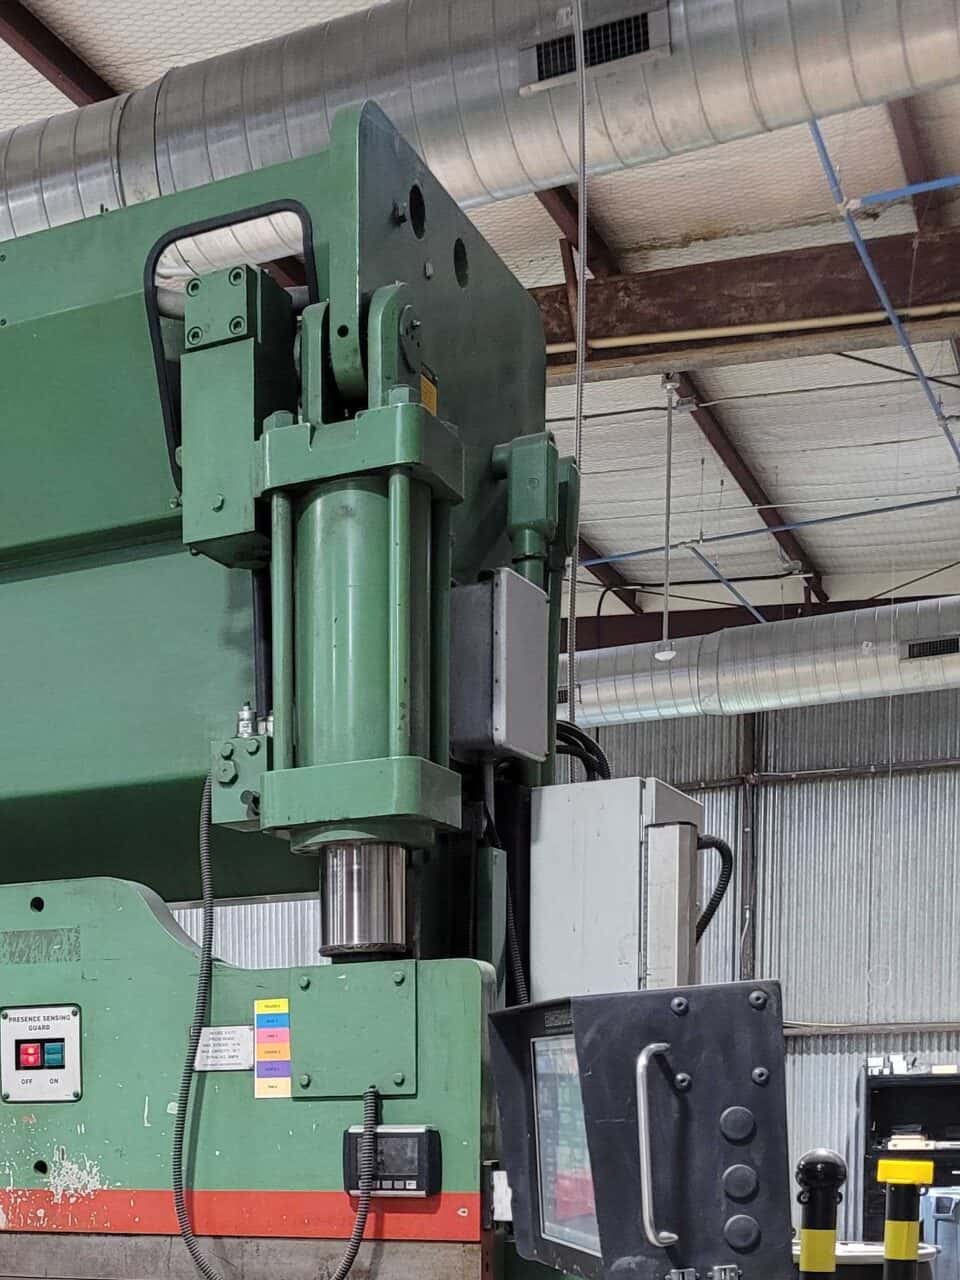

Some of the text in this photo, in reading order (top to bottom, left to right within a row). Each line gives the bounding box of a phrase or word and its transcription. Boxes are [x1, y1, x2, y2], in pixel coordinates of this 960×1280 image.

[8, 1014, 71, 1023] PRESENCE SENSING
[28, 1024, 51, 1032] GUARD
